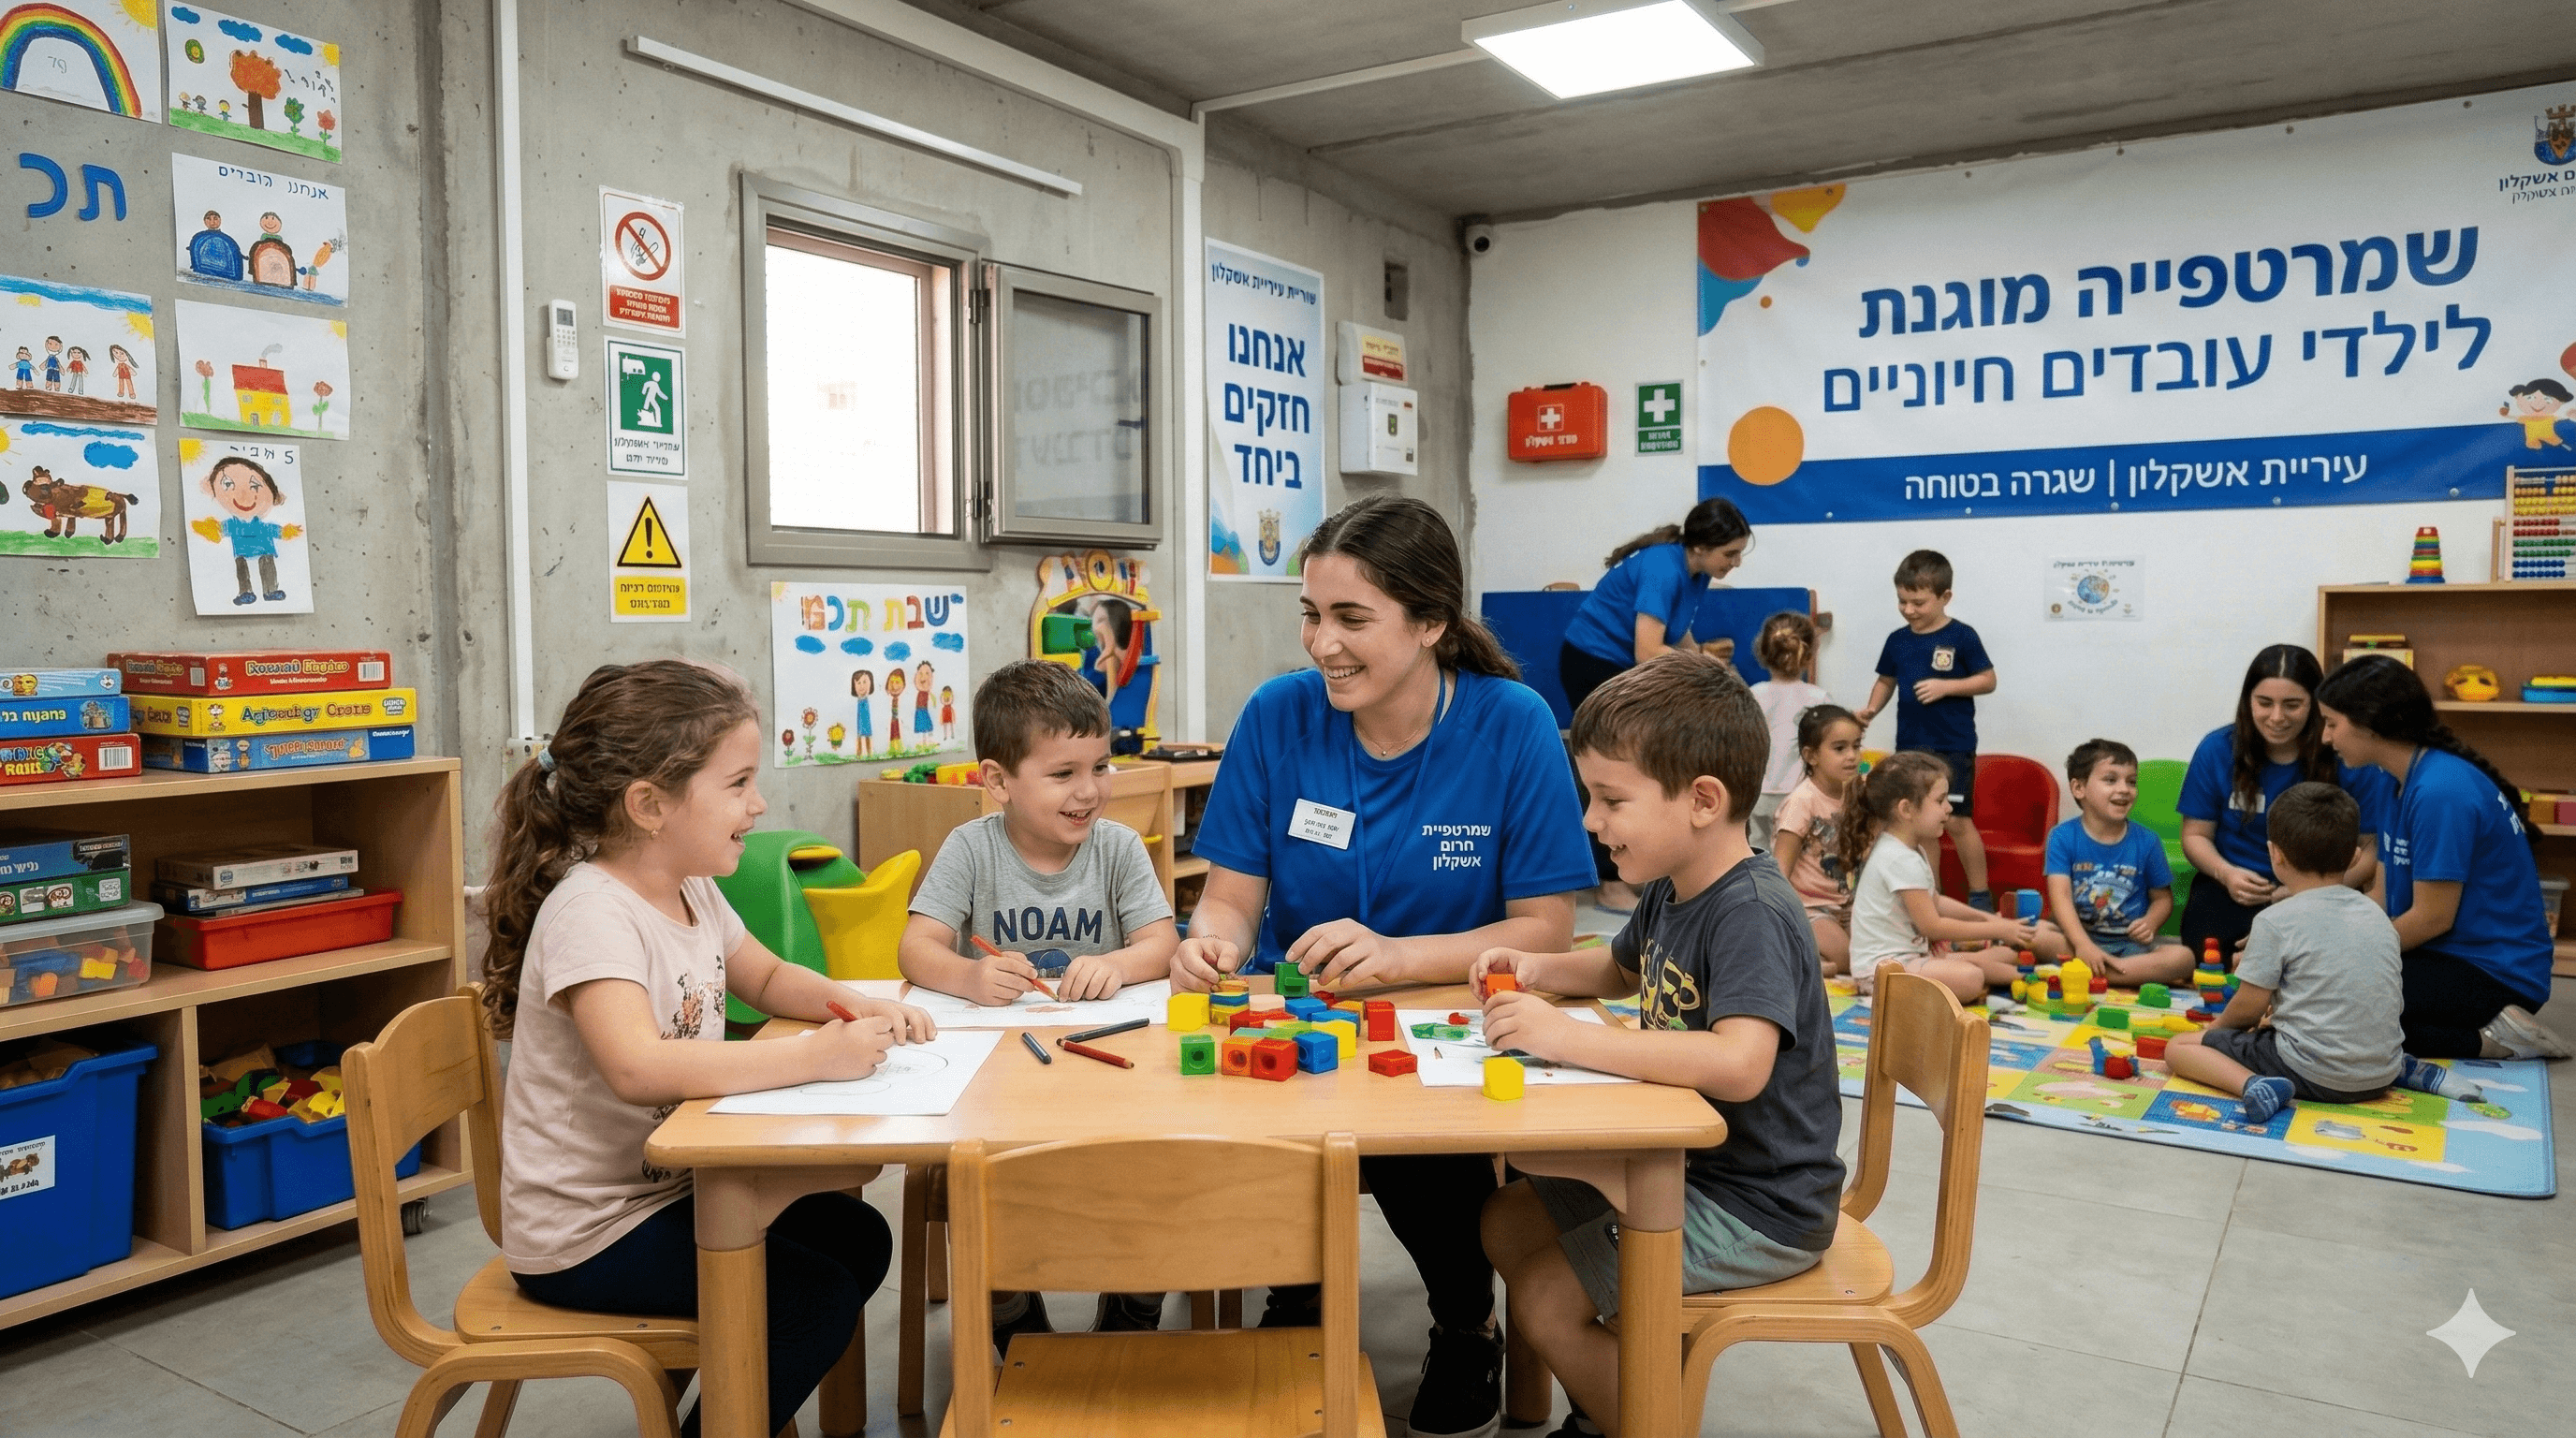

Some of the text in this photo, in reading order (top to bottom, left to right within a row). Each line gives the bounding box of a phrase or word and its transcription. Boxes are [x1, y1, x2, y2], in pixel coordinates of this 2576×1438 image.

[2499, 171, 2559, 192] אשקלון
[1859, 228, 2479, 338] שמרטפייה מוגנת
[1228, 324, 1307, 378] אנחנו
[1823, 305, 2492, 413] לילדי עובדים חיוניים
[1223, 382, 1310, 437] חזקים
[1233, 444, 1302, 490] ביחד
[2010, 468, 2096, 496] שגרה
[2129, 458, 2249, 498] אשקלון
[2259, 454, 2367, 485] עיריית
[1904, 473, 2001, 501] בטוחה
[1421, 825, 1492, 837] שמרטפיית
[1439, 840, 1475, 852] חרום
[1432, 853, 1482, 871] אשקלון
[993, 905, 1104, 946] NOAM
